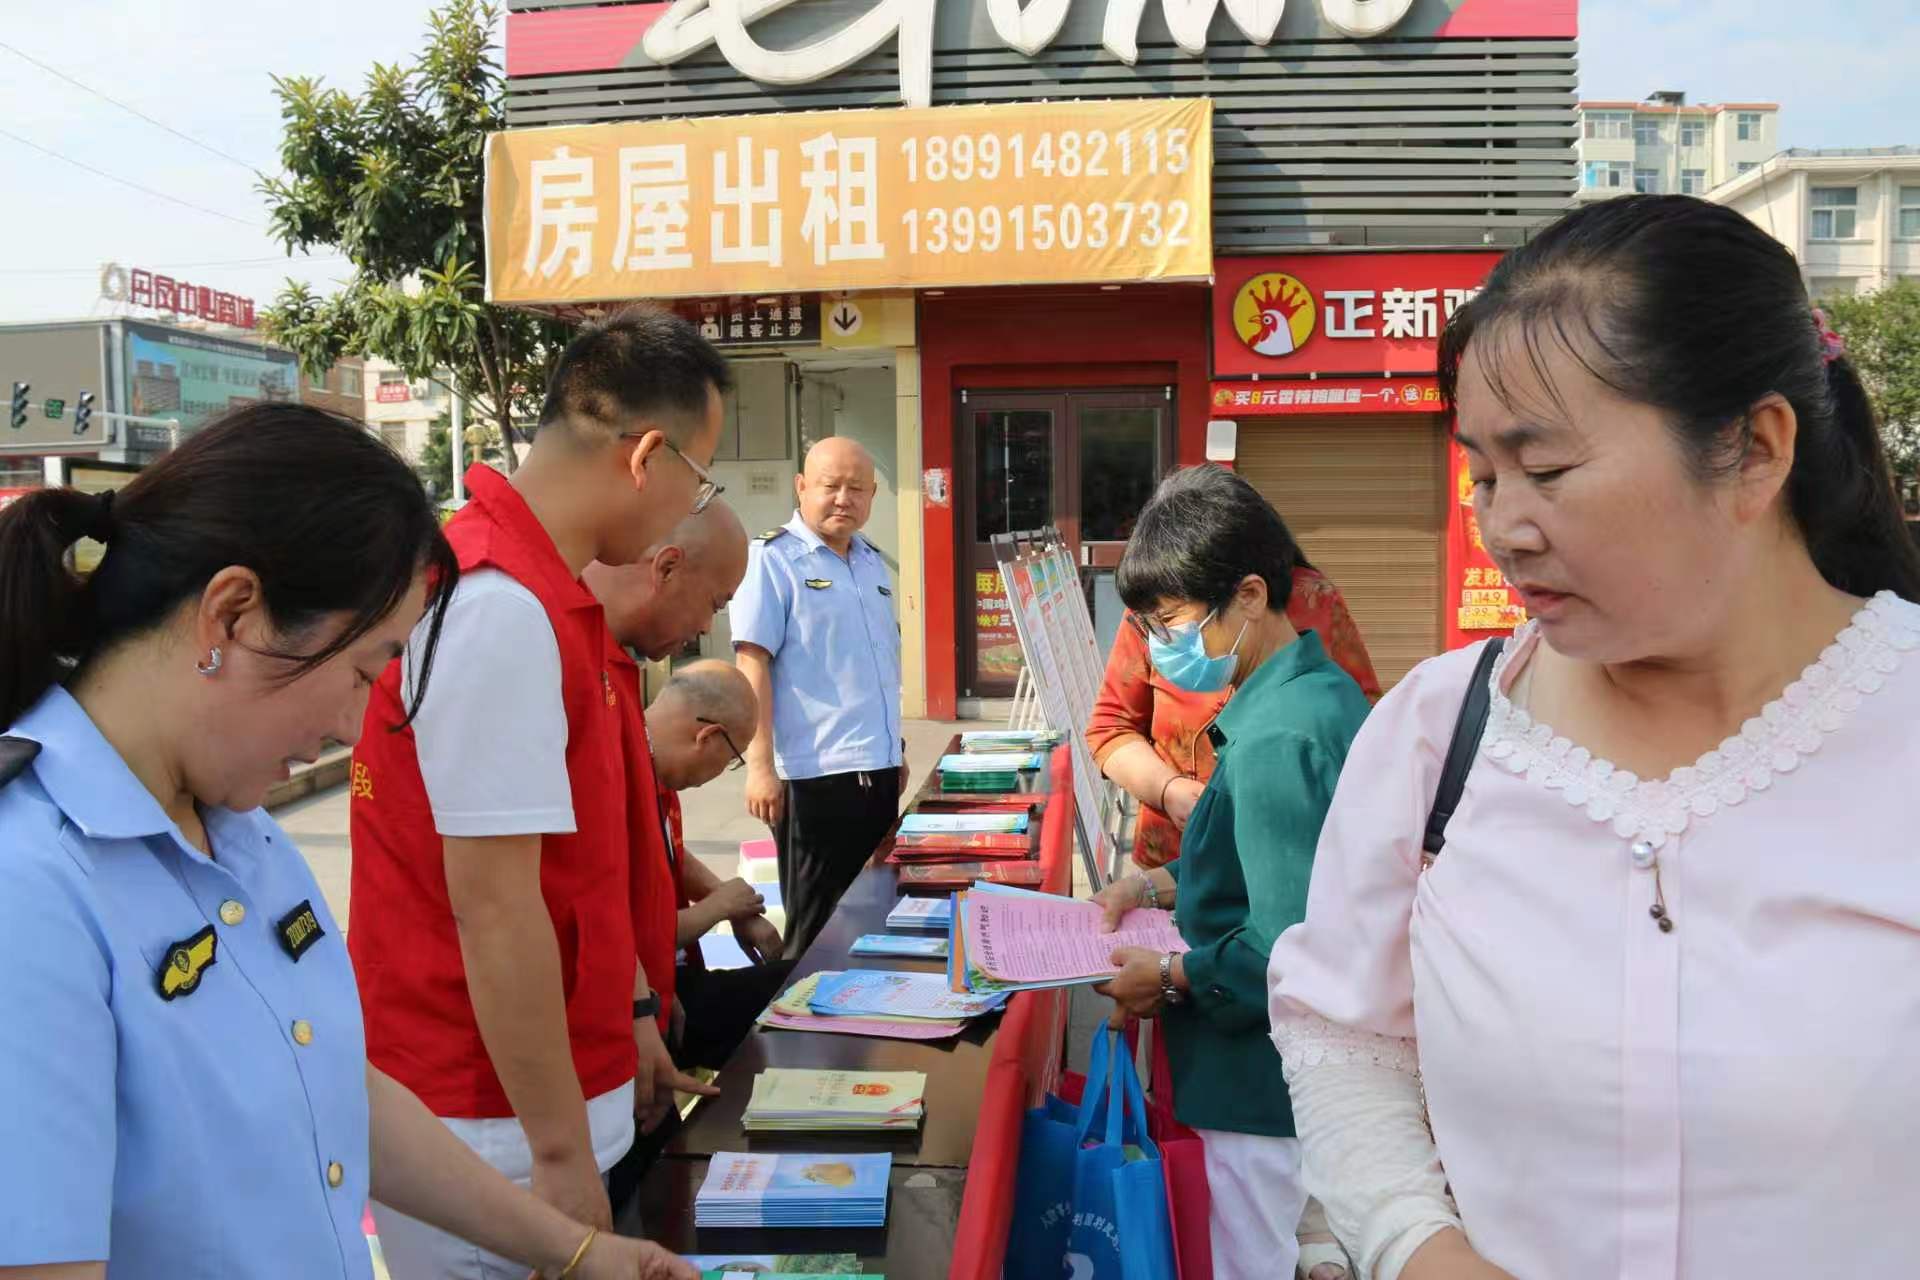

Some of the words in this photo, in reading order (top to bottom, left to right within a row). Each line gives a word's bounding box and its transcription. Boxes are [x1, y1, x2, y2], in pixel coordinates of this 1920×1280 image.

[901, 128, 1189, 183] 18991482115
[522, 131, 885, 279] 房屋出租
[902, 199, 1192, 257] 13991503732
[730, 322, 802, 338] 顾客止步
